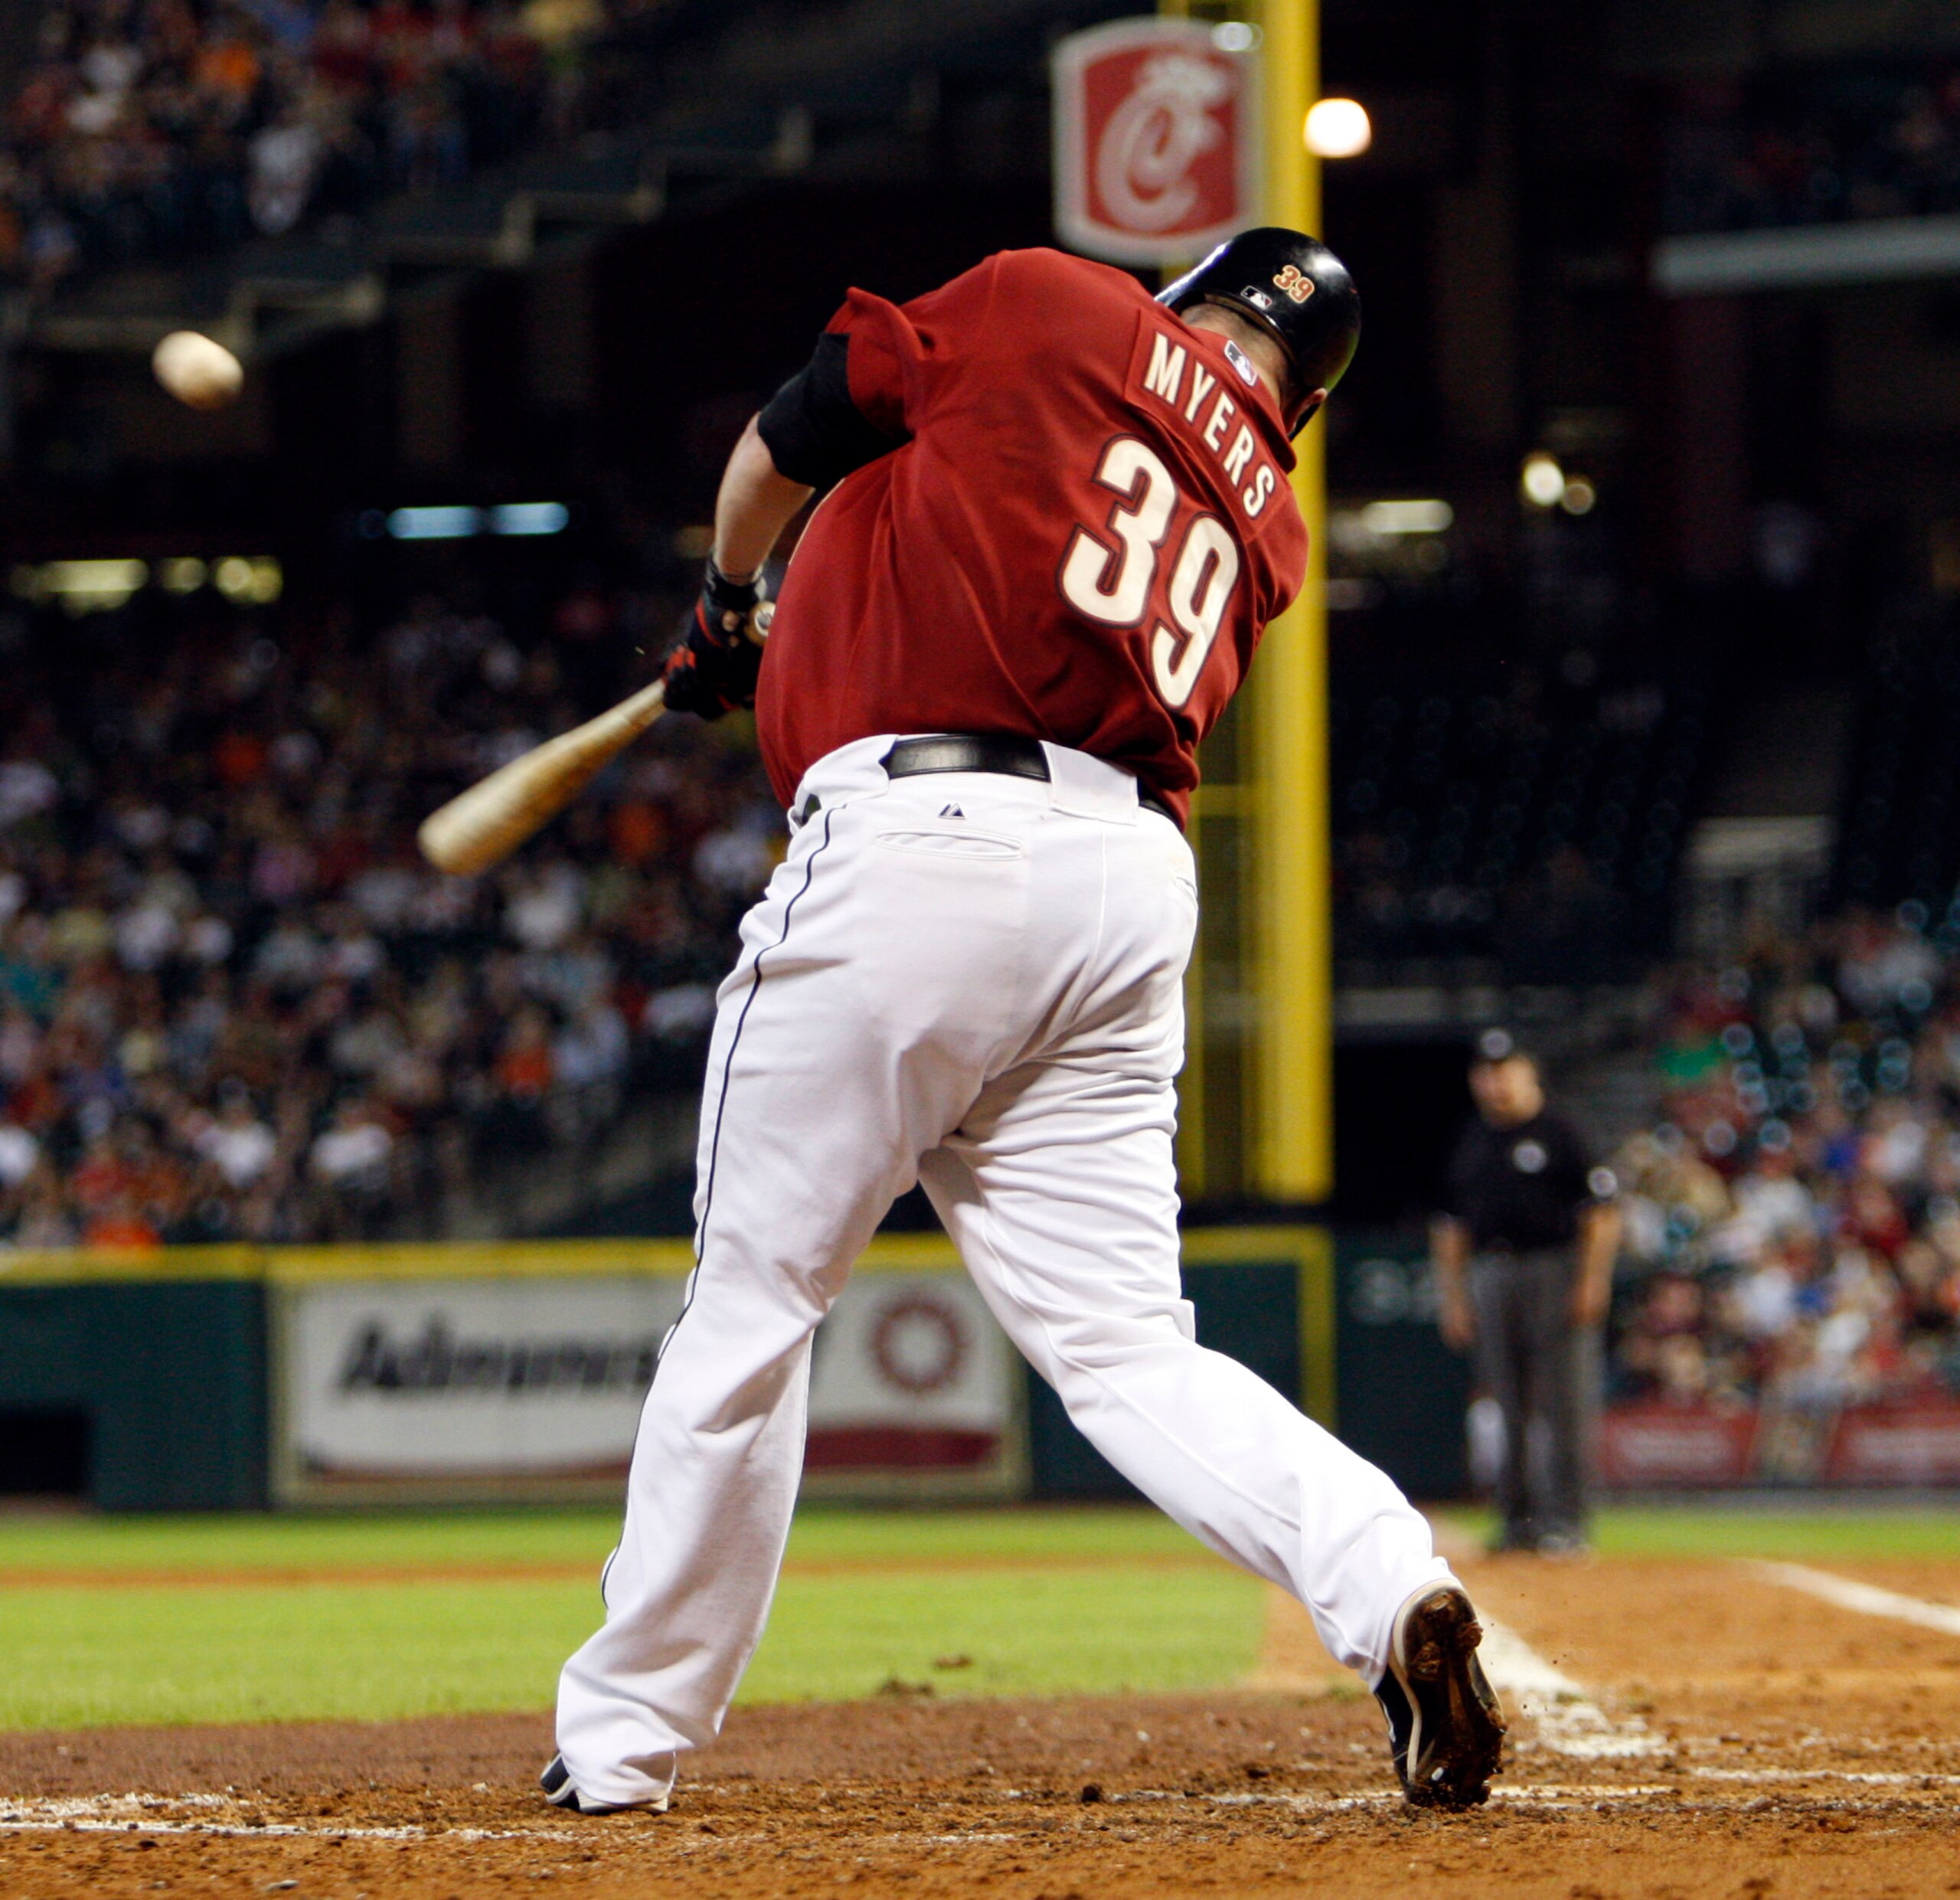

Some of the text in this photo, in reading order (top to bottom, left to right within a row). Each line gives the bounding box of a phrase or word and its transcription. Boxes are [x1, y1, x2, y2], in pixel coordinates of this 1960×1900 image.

[1272, 264, 1315, 303] 39
[1142, 330, 1276, 518] MYERS
[1056, 432, 1240, 713] 39
